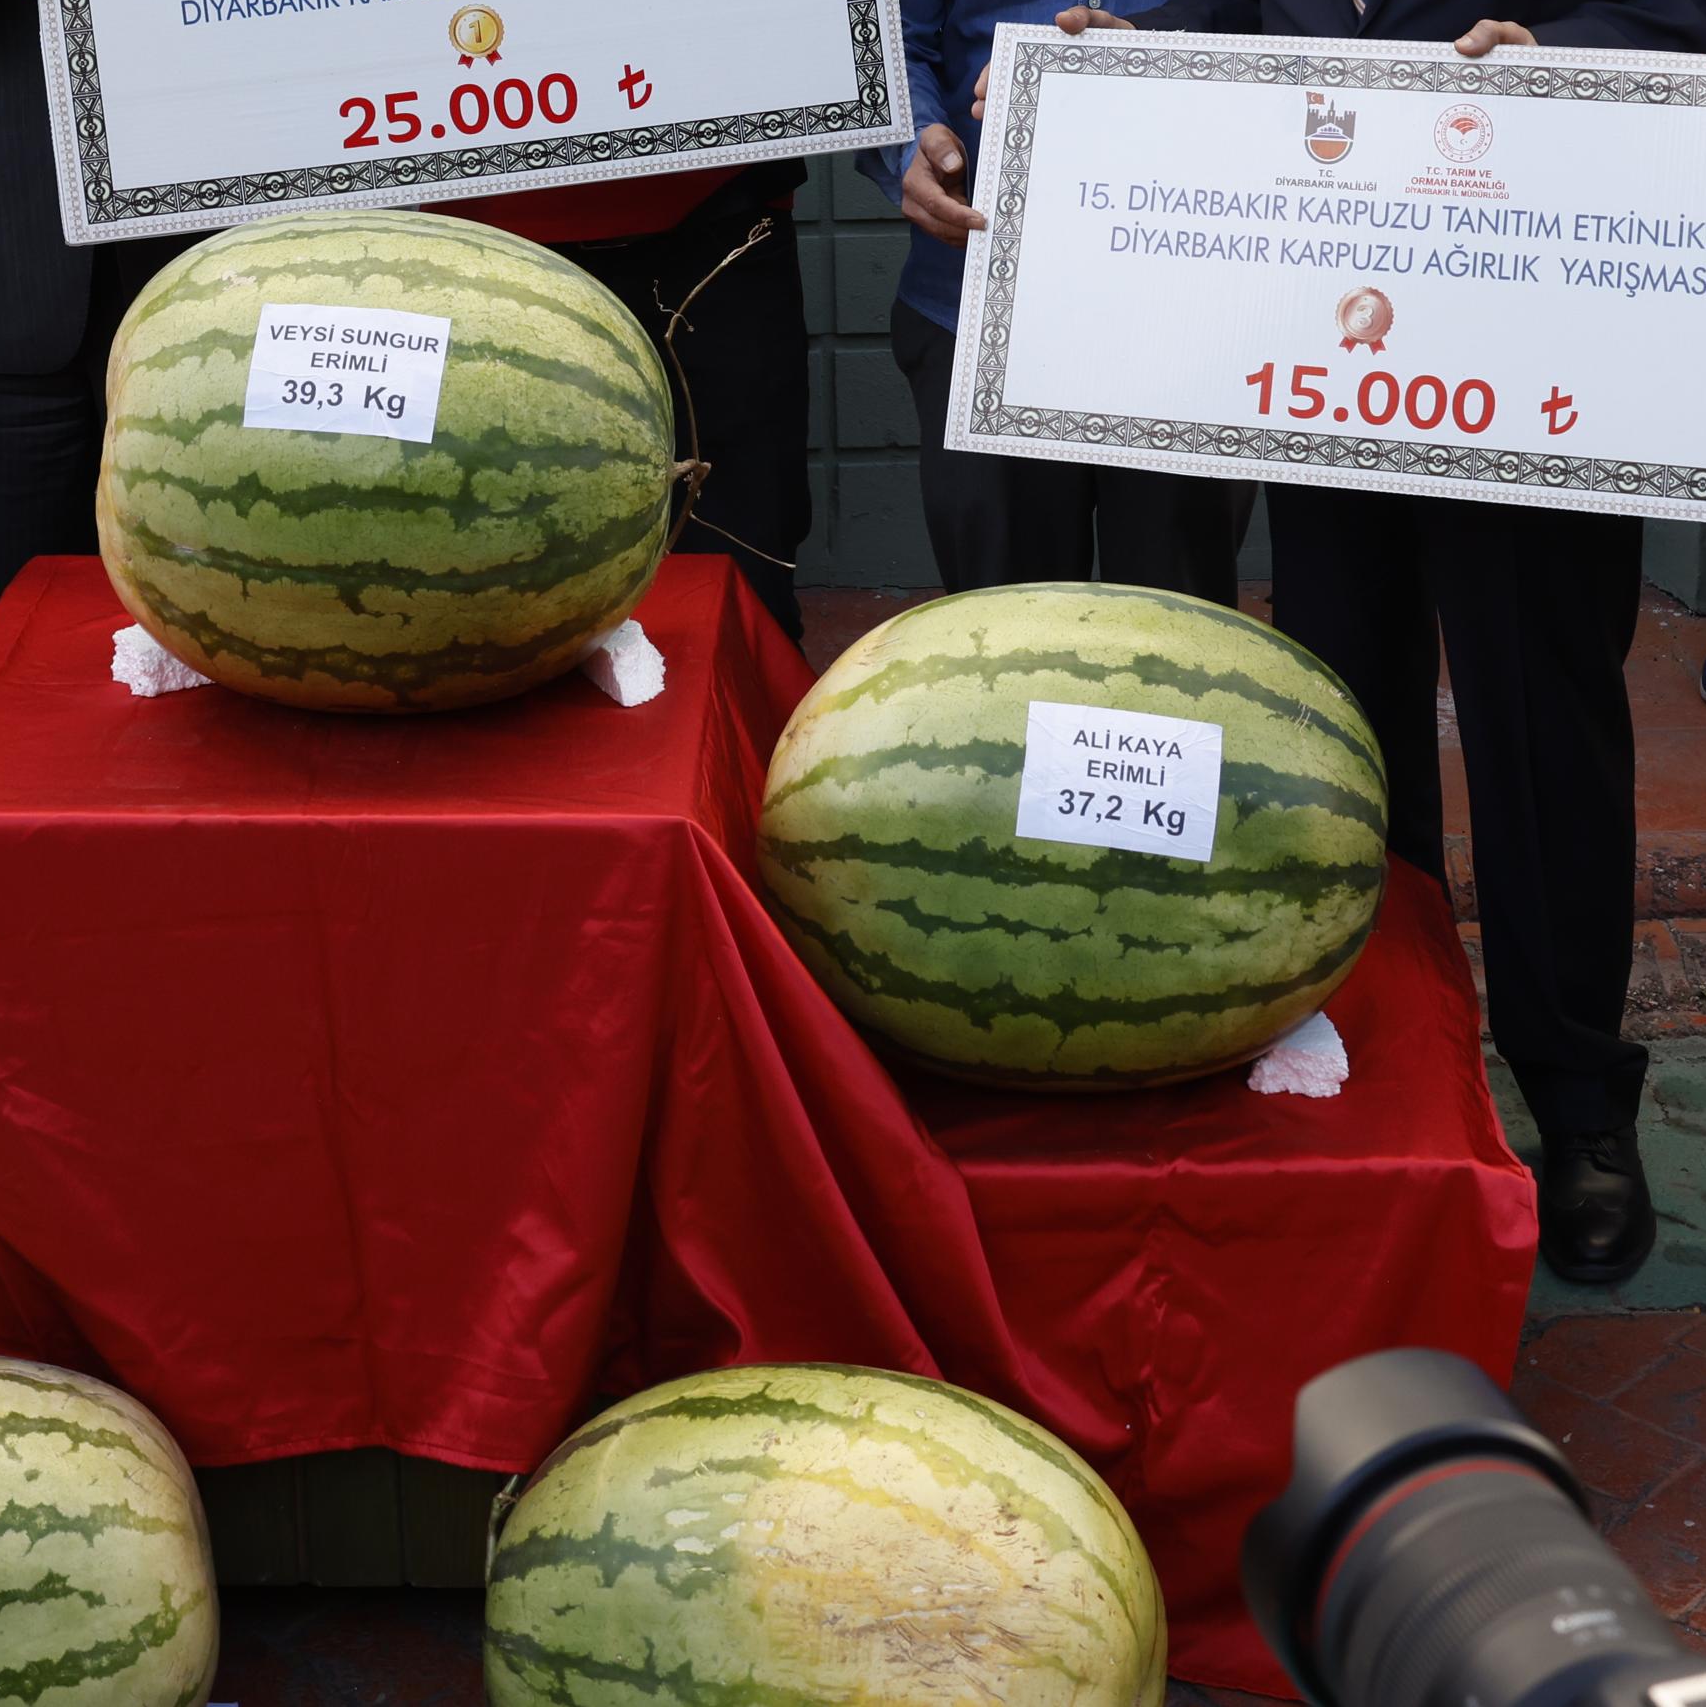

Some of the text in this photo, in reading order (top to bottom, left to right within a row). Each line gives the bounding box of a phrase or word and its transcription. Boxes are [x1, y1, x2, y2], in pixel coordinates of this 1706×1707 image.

[339, 72, 578, 149] 25.000
[1275, 176, 1378, 192] DİYARBAKIR VALİLİĞİ
[1318, 169, 1335, 178] T.C.
[1410, 176, 1506, 190] ORMAN BAKANLIĞI
[1426, 166, 1493, 178] T.C. TARIM VE
[1404, 186, 1451, 196] DİYARBAKIR
[1078, 181, 1116, 210] 15.
[1127, 179, 1288, 222] DİYARBAKIR
[1297, 195, 1432, 231] KARPUZU
[1442, 204, 1562, 240] TANITIM
[1110, 220, 1270, 264] DİYARBAKIR
[1279, 237, 1414, 274] KARPUZU
[1422, 242, 1541, 283] AĞIRLIK
[270, 324, 440, 354] VEYSİ SUNGUR
[310, 351, 388, 373] ERİMLİ
[281, 379, 406, 419] 39,3 Kg
[1245, 362, 1496, 435] 15.000
[1073, 729, 1183, 759] ALİ KAYA
[1087, 759, 1166, 787] ERİMLİ
[1058, 788, 1186, 837] 37,2 Kg
